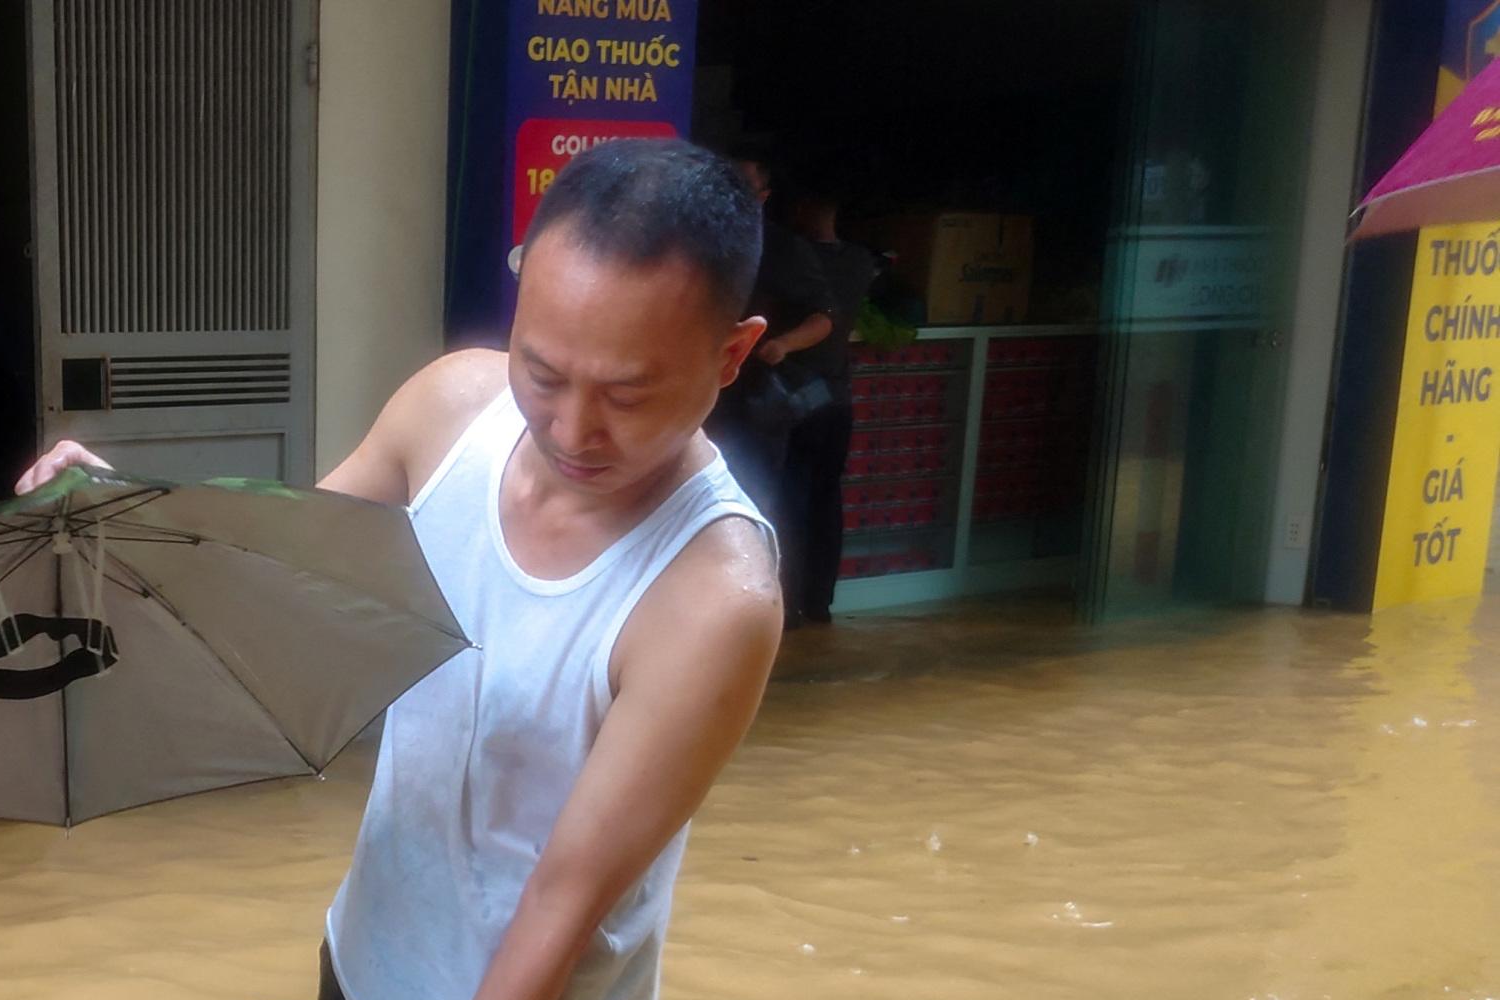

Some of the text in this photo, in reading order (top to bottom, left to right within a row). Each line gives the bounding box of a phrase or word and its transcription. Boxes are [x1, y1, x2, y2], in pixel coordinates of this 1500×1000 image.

[527, 34, 681, 67] GIAO THUỐC
[548, 69, 658, 105] TẬN NHÀ
[1429, 228, 1500, 277] THUỐ
[1424, 295, 1500, 342] CHÍNH
[1419, 360, 1493, 407] HÃNG
[1422, 458, 1465, 505] GIÁ
[1413, 516, 1462, 568] TỐT
